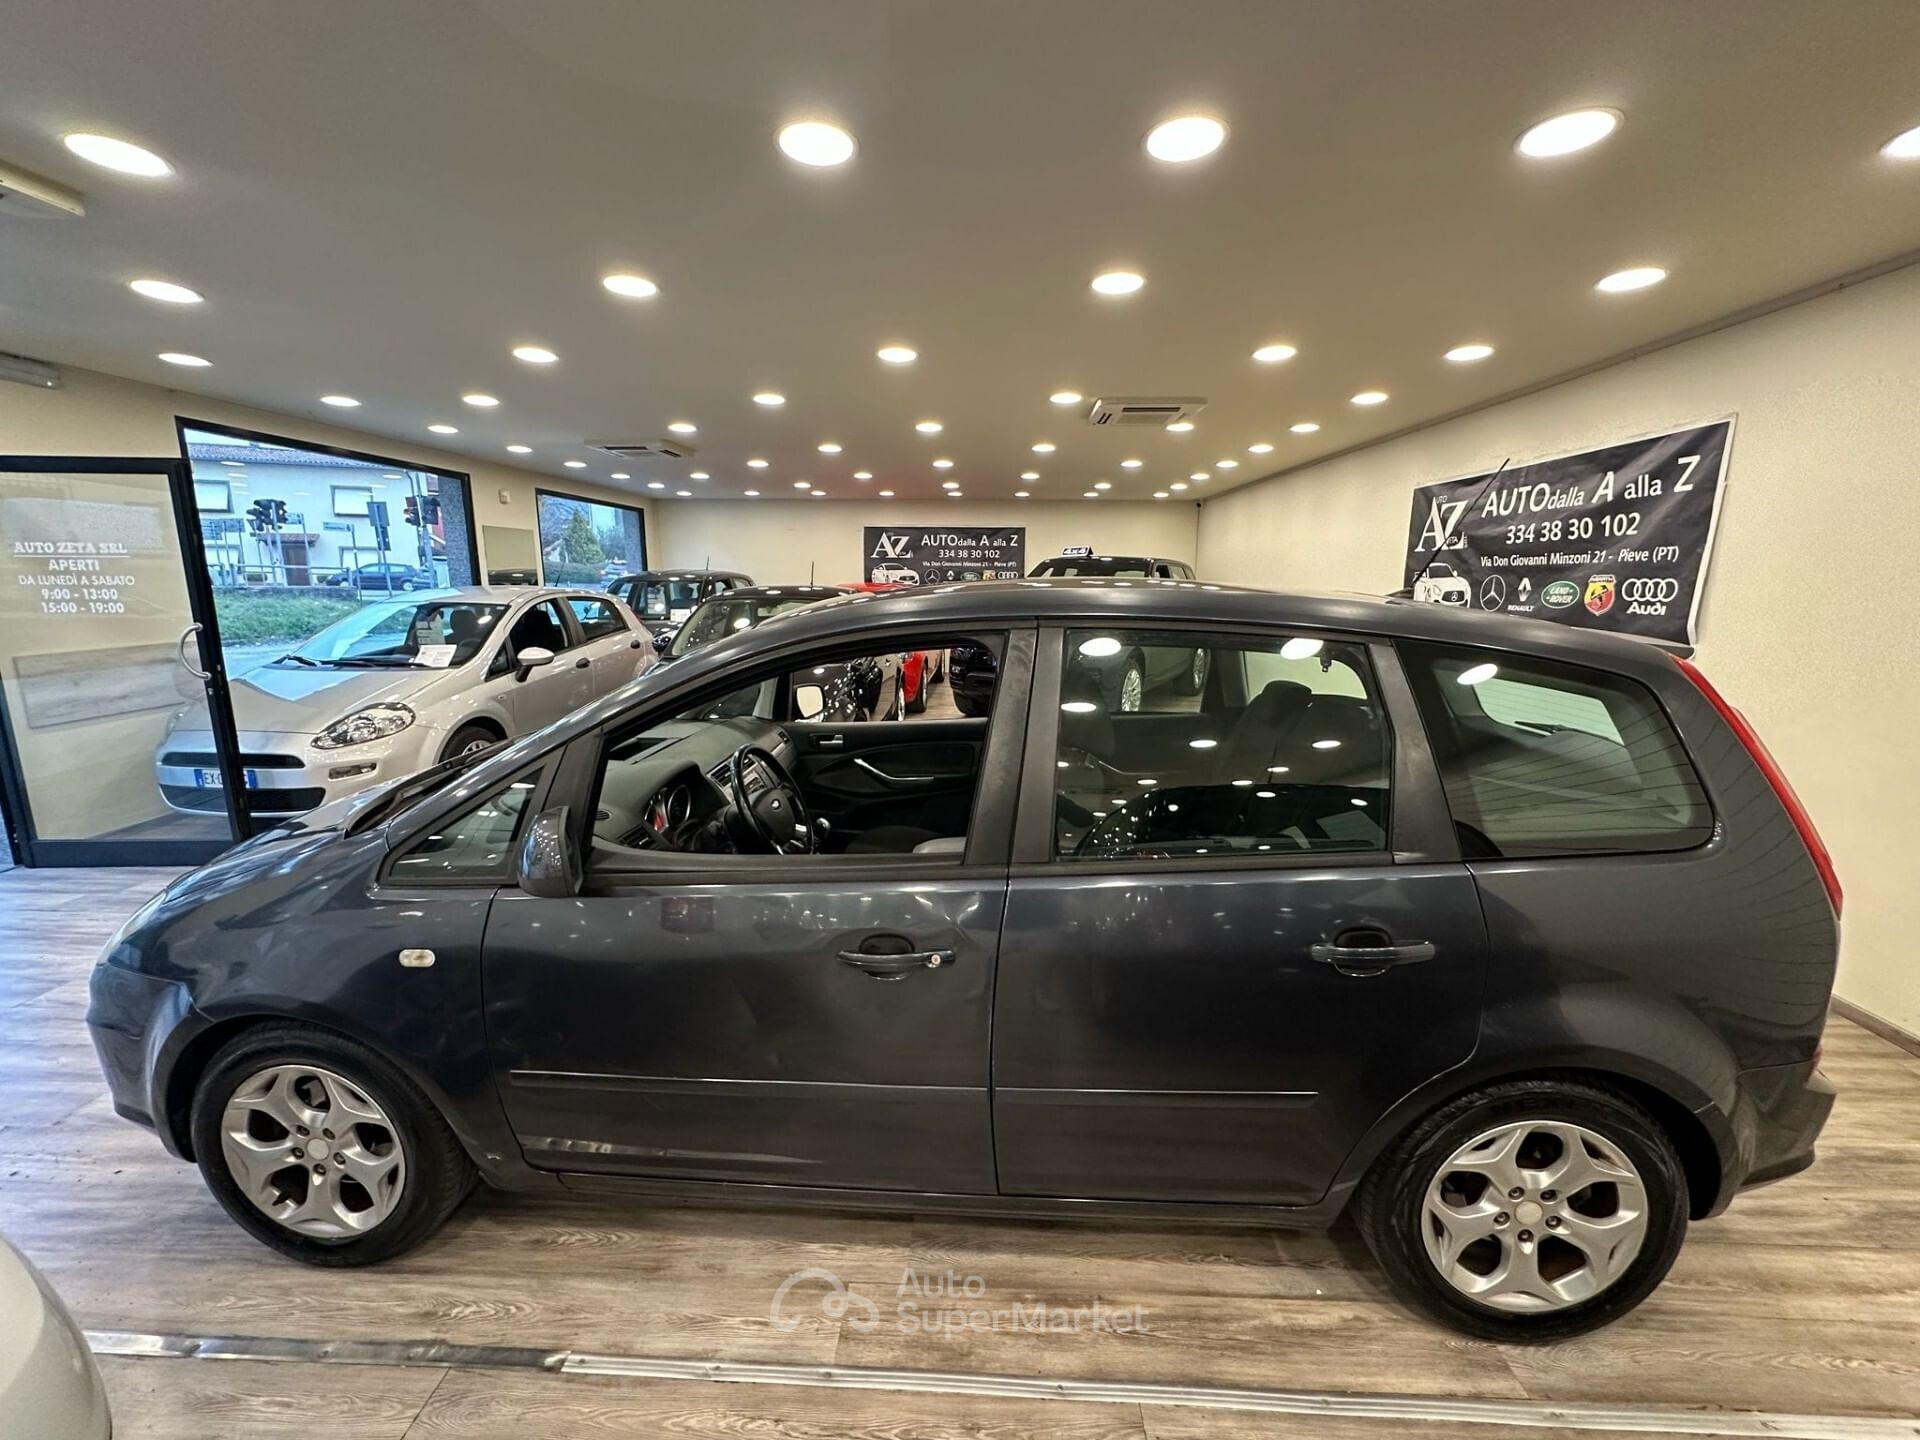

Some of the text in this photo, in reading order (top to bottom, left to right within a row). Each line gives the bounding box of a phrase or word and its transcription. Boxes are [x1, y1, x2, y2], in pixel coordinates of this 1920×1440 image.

[1591, 471, 1614, 504] A
[1624, 474, 1662, 499] alla
[1673, 454, 1701, 493] Z
[1505, 512, 1640, 545] 334 38 30 102
[979, 535, 990, 547] A
[992, 539, 1007, 547] alla
[1009, 535, 1019, 547] Z
[14, 541, 128, 554] AUTO ZETA SRL
[938, 549, 1000, 558] 334 38 30 102
[1480, 556, 1492, 567] Via
[1493, 556, 1509, 567] Don
[1510, 553, 1548, 567] Giovanni
[1549, 551, 1591, 565] Minzoni
[1592, 550, 1607, 563] 21
[1617, 547, 1649, 562] Pieve
[1652, 545, 1680, 564] (PT)
[48, 559, 100, 571] APERTI
[18, 573, 136, 585] DA LUNEDÌ A SABATO
[41, 588, 71, 600] 9:00
[82, 588, 118, 600] 13:00
[41, 602, 77, 613] 15:00
[88, 602, 125, 613] 19:00
[1626, 602, 1667, 616] Audi
